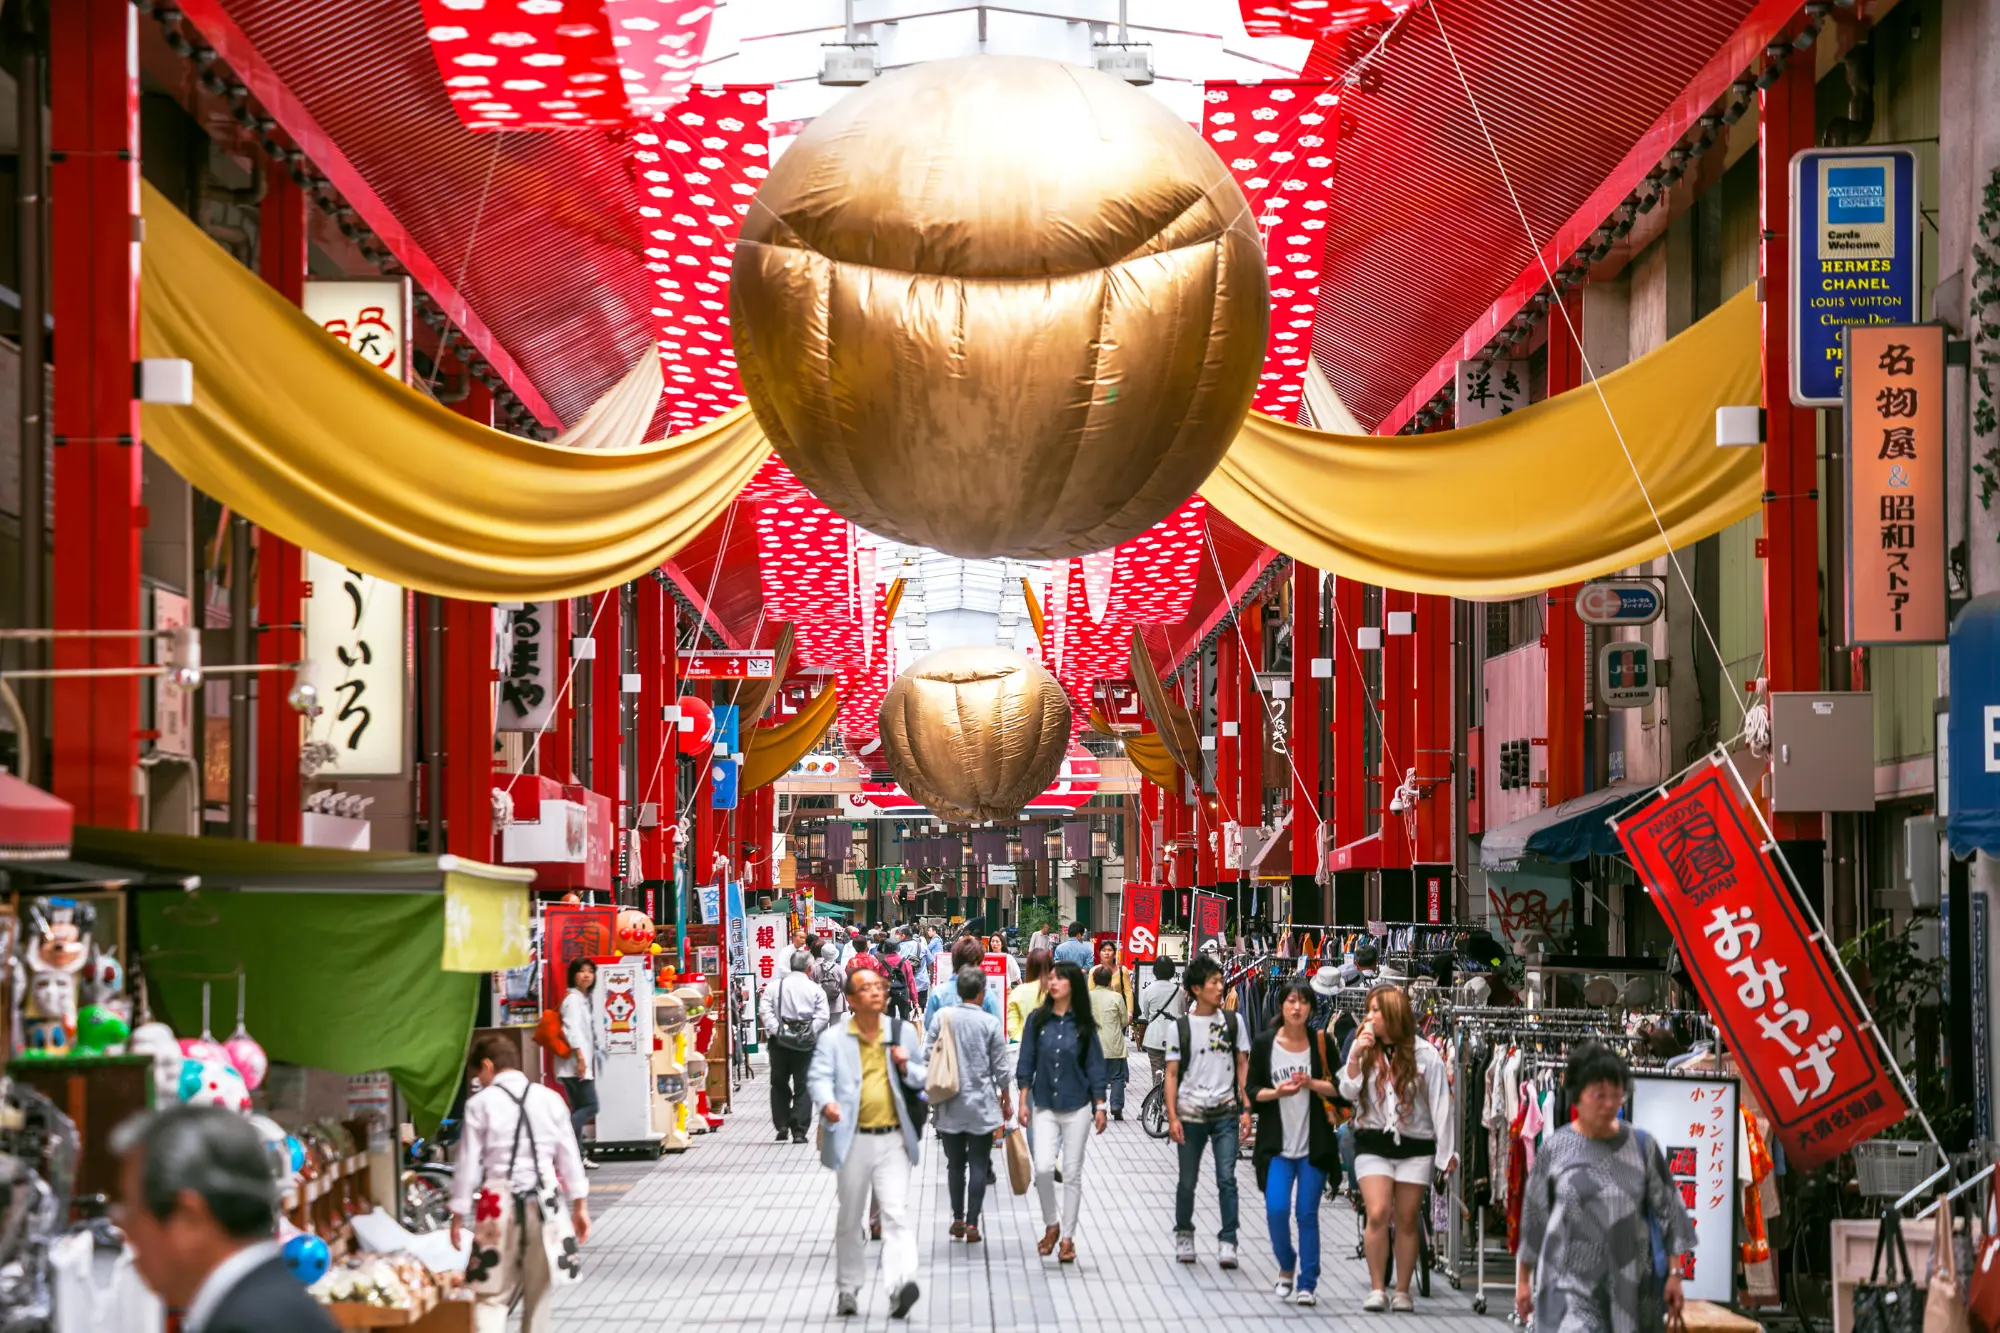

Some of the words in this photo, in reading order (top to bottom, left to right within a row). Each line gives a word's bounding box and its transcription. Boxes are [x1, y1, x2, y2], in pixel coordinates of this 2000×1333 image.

[1828, 186, 1882, 198] AMERICAN
[1839, 197, 1885, 208] EXPRESS
[1828, 230, 1861, 240] Cards
[1828, 241, 1881, 250] Welcome
[1822, 278, 1890, 291] CHANEL
[1810, 297, 1845, 308] LOUIS
[1849, 296, 1902, 306] VUITTON
[1820, 313, 1866, 326] Christian
[1869, 313, 1892, 324] Dior
[358, 331, 381, 356] 大
[1467, 372, 1495, 409] 洋
[749, 660, 770, 670] N-2
[1610, 664, 1647, 674] JCB
[851, 793, 867, 804] 祝
[1647, 797, 1705, 839] NAGOYA
[1689, 872, 1738, 907] JAPAN
[756, 925, 776, 996] 観音
[1702, 903, 1843, 1107] おみやげ
[1689, 1087, 1706, 1138] 小物
[1796, 1088, 1886, 1150] 大須名物屋
[1709, 1085, 1727, 1209] ブランドバッグ
